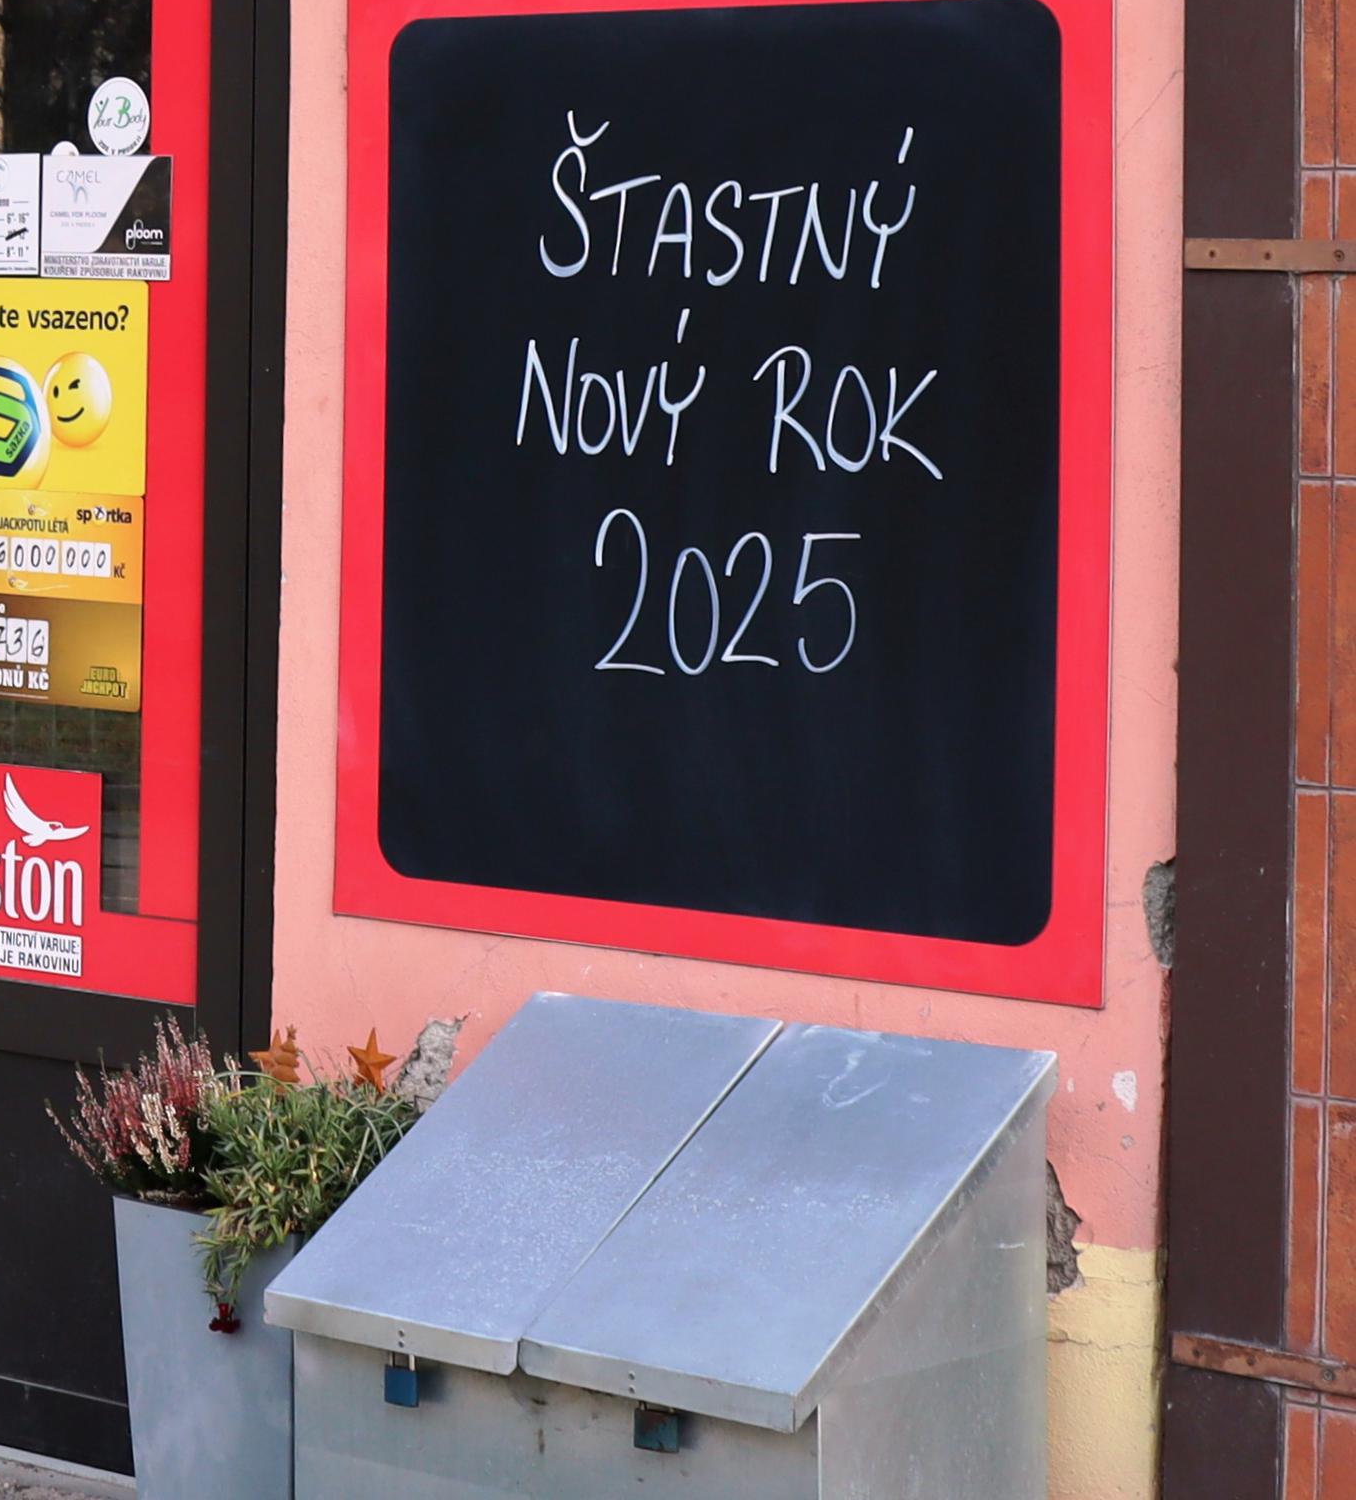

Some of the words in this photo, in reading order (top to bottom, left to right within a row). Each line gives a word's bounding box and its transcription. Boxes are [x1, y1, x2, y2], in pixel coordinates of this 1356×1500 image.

[125, 219, 163, 250] ploom
[127, 267, 167, 278] RAKOVINU
[28, 304, 130, 331] vsazeno?
[516, 309, 707, 468] NOVÝ
[753, 345, 944, 481] ROK
[5, 420, 30, 459] sazka
[594, 508, 862, 676] 2025
[28, 668, 49, 691] KČ
[80, 679, 128, 699] JACKPOT
[18, 952, 80, 974] RAKOVINU
